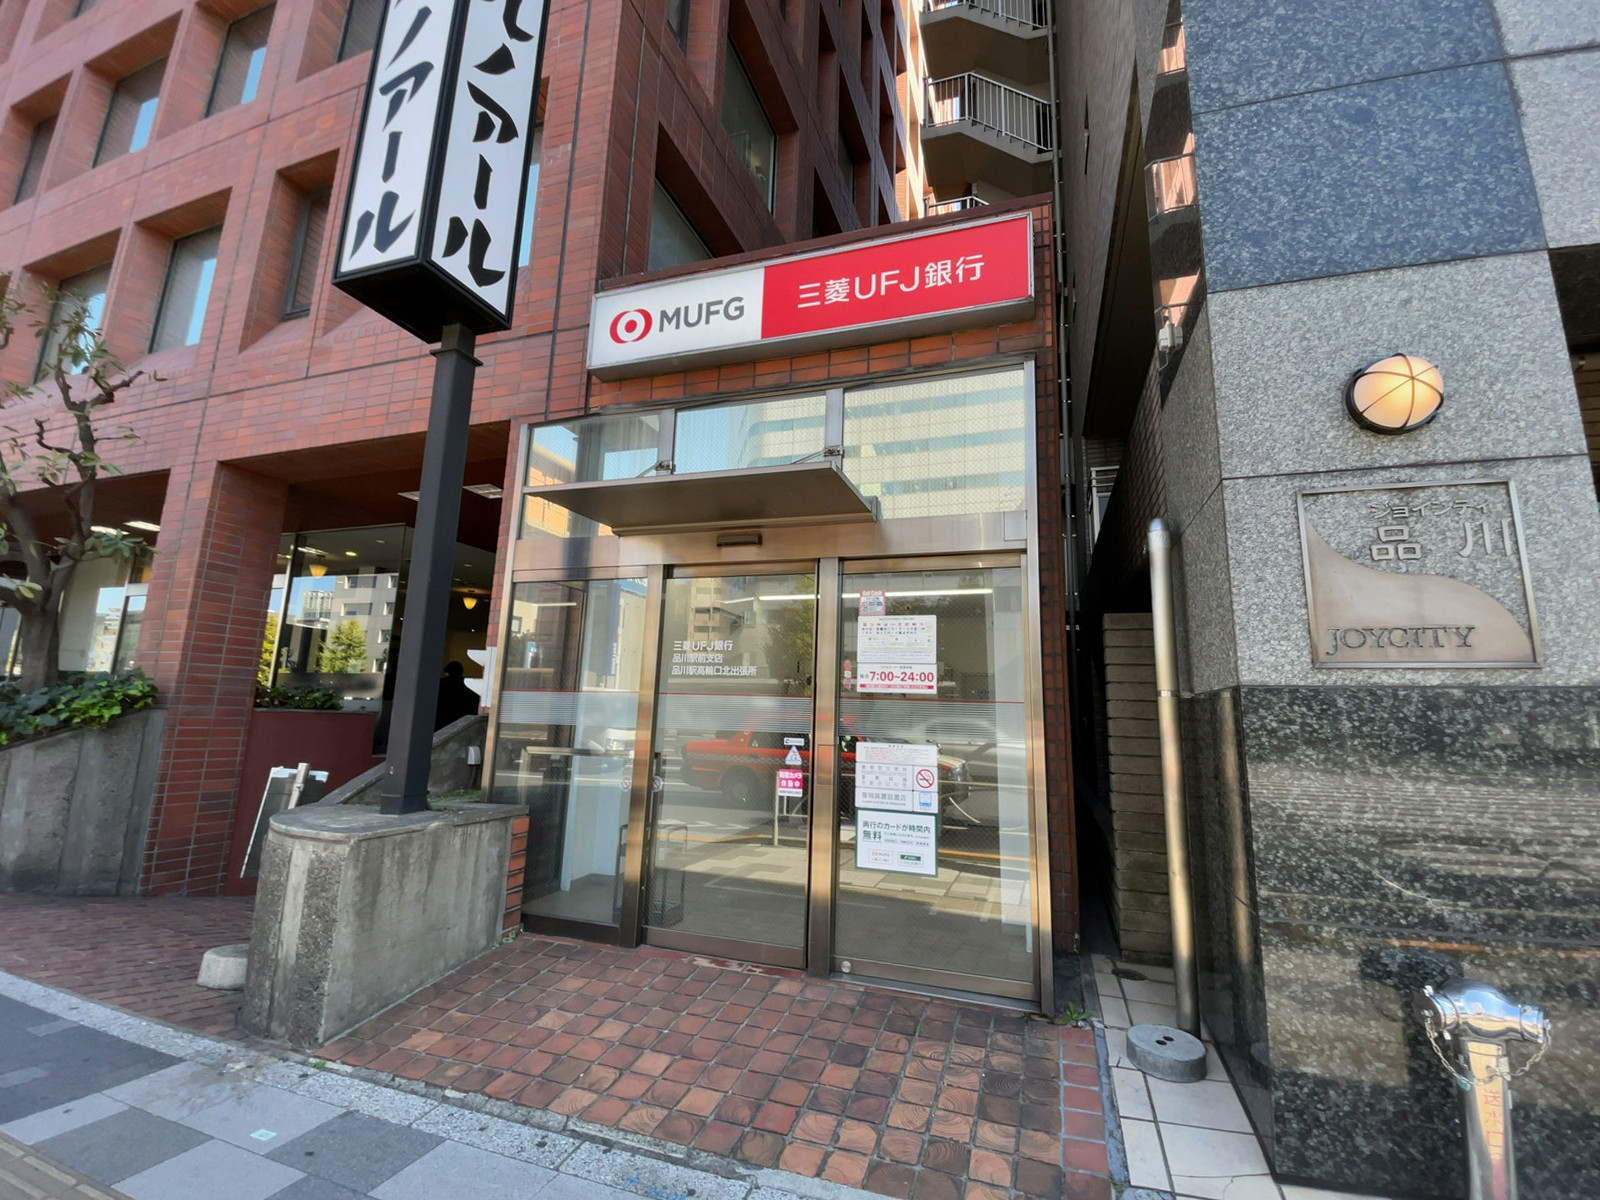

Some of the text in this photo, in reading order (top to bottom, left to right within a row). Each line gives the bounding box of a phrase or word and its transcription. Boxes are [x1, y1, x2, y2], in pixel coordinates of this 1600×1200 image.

[797, 253, 985, 309] 三菱UFJ銀行
[658, 296, 745, 333] MUFG
[1370, 519, 1513, 561] 品川
[673, 640, 733, 651] 三菱UFJ銀行
[1325, 626, 1476, 656] JOYCITY
[672, 653, 723, 664] 品川駅前支店
[862, 830, 882, 840] 無料
